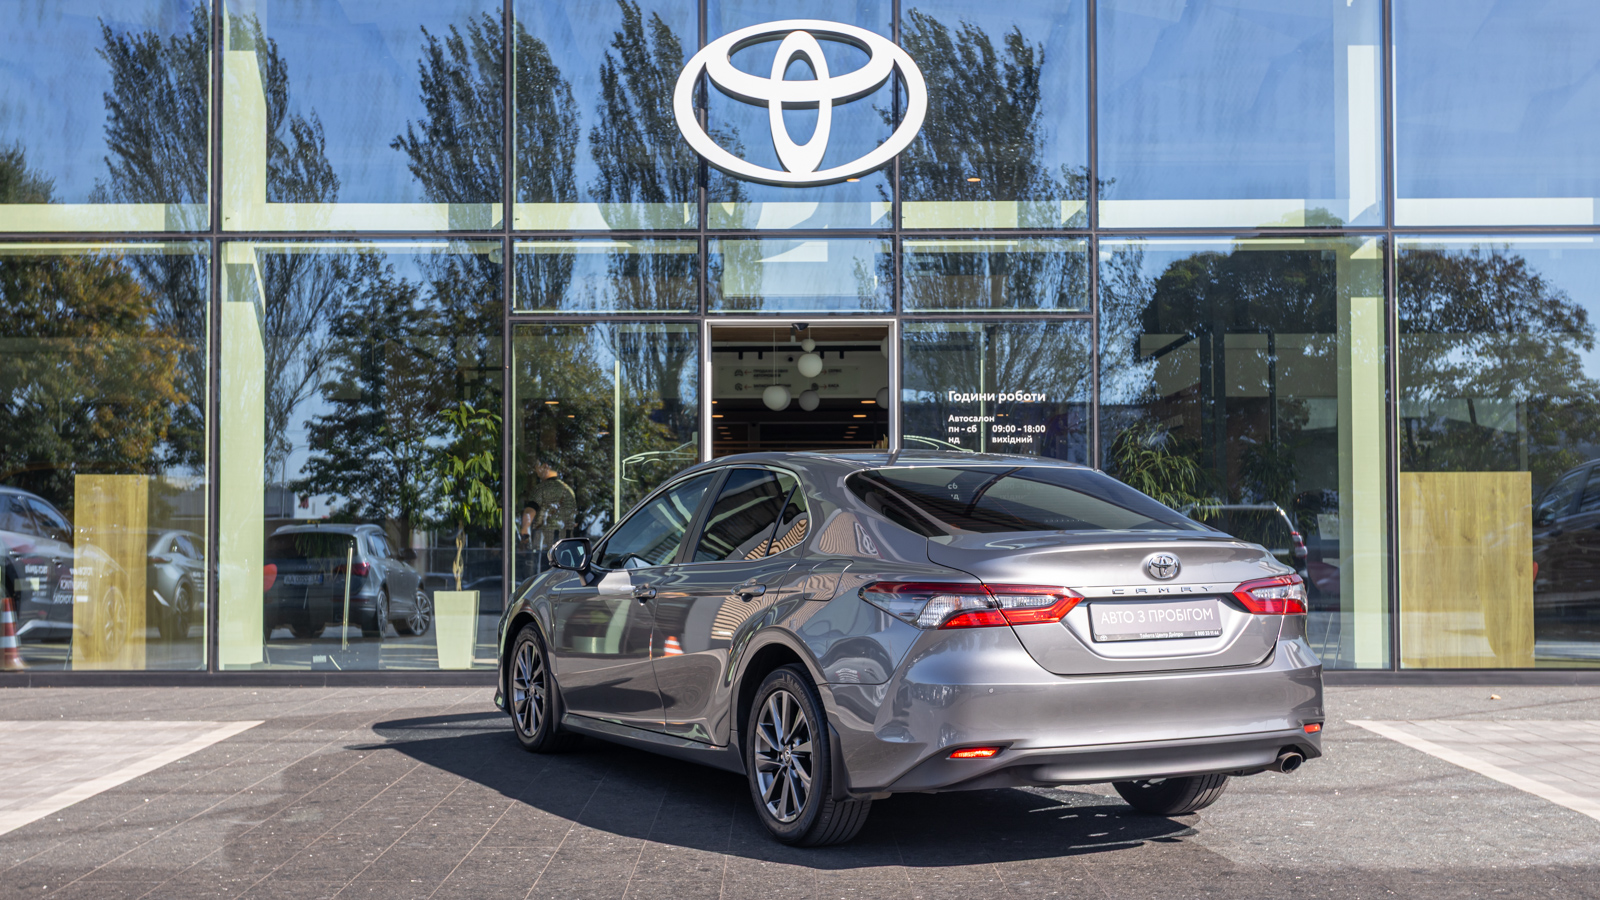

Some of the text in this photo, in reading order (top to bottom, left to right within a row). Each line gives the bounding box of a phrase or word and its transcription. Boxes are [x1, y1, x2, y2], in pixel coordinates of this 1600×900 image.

[948, 390, 1046, 404] Години роботи
[948, 414, 995, 422] Автосалон
[967, 424, 977, 433] сб
[992, 425, 1016, 433] 09:00
[1023, 425, 1046, 433] 18:00
[992, 435, 1033, 444] вихідний
[1111, 586, 1213, 595] CAMRY
[1100, 610, 1135, 625] АВТО
[1148, 607, 1214, 623] ПРОБІГОМ
